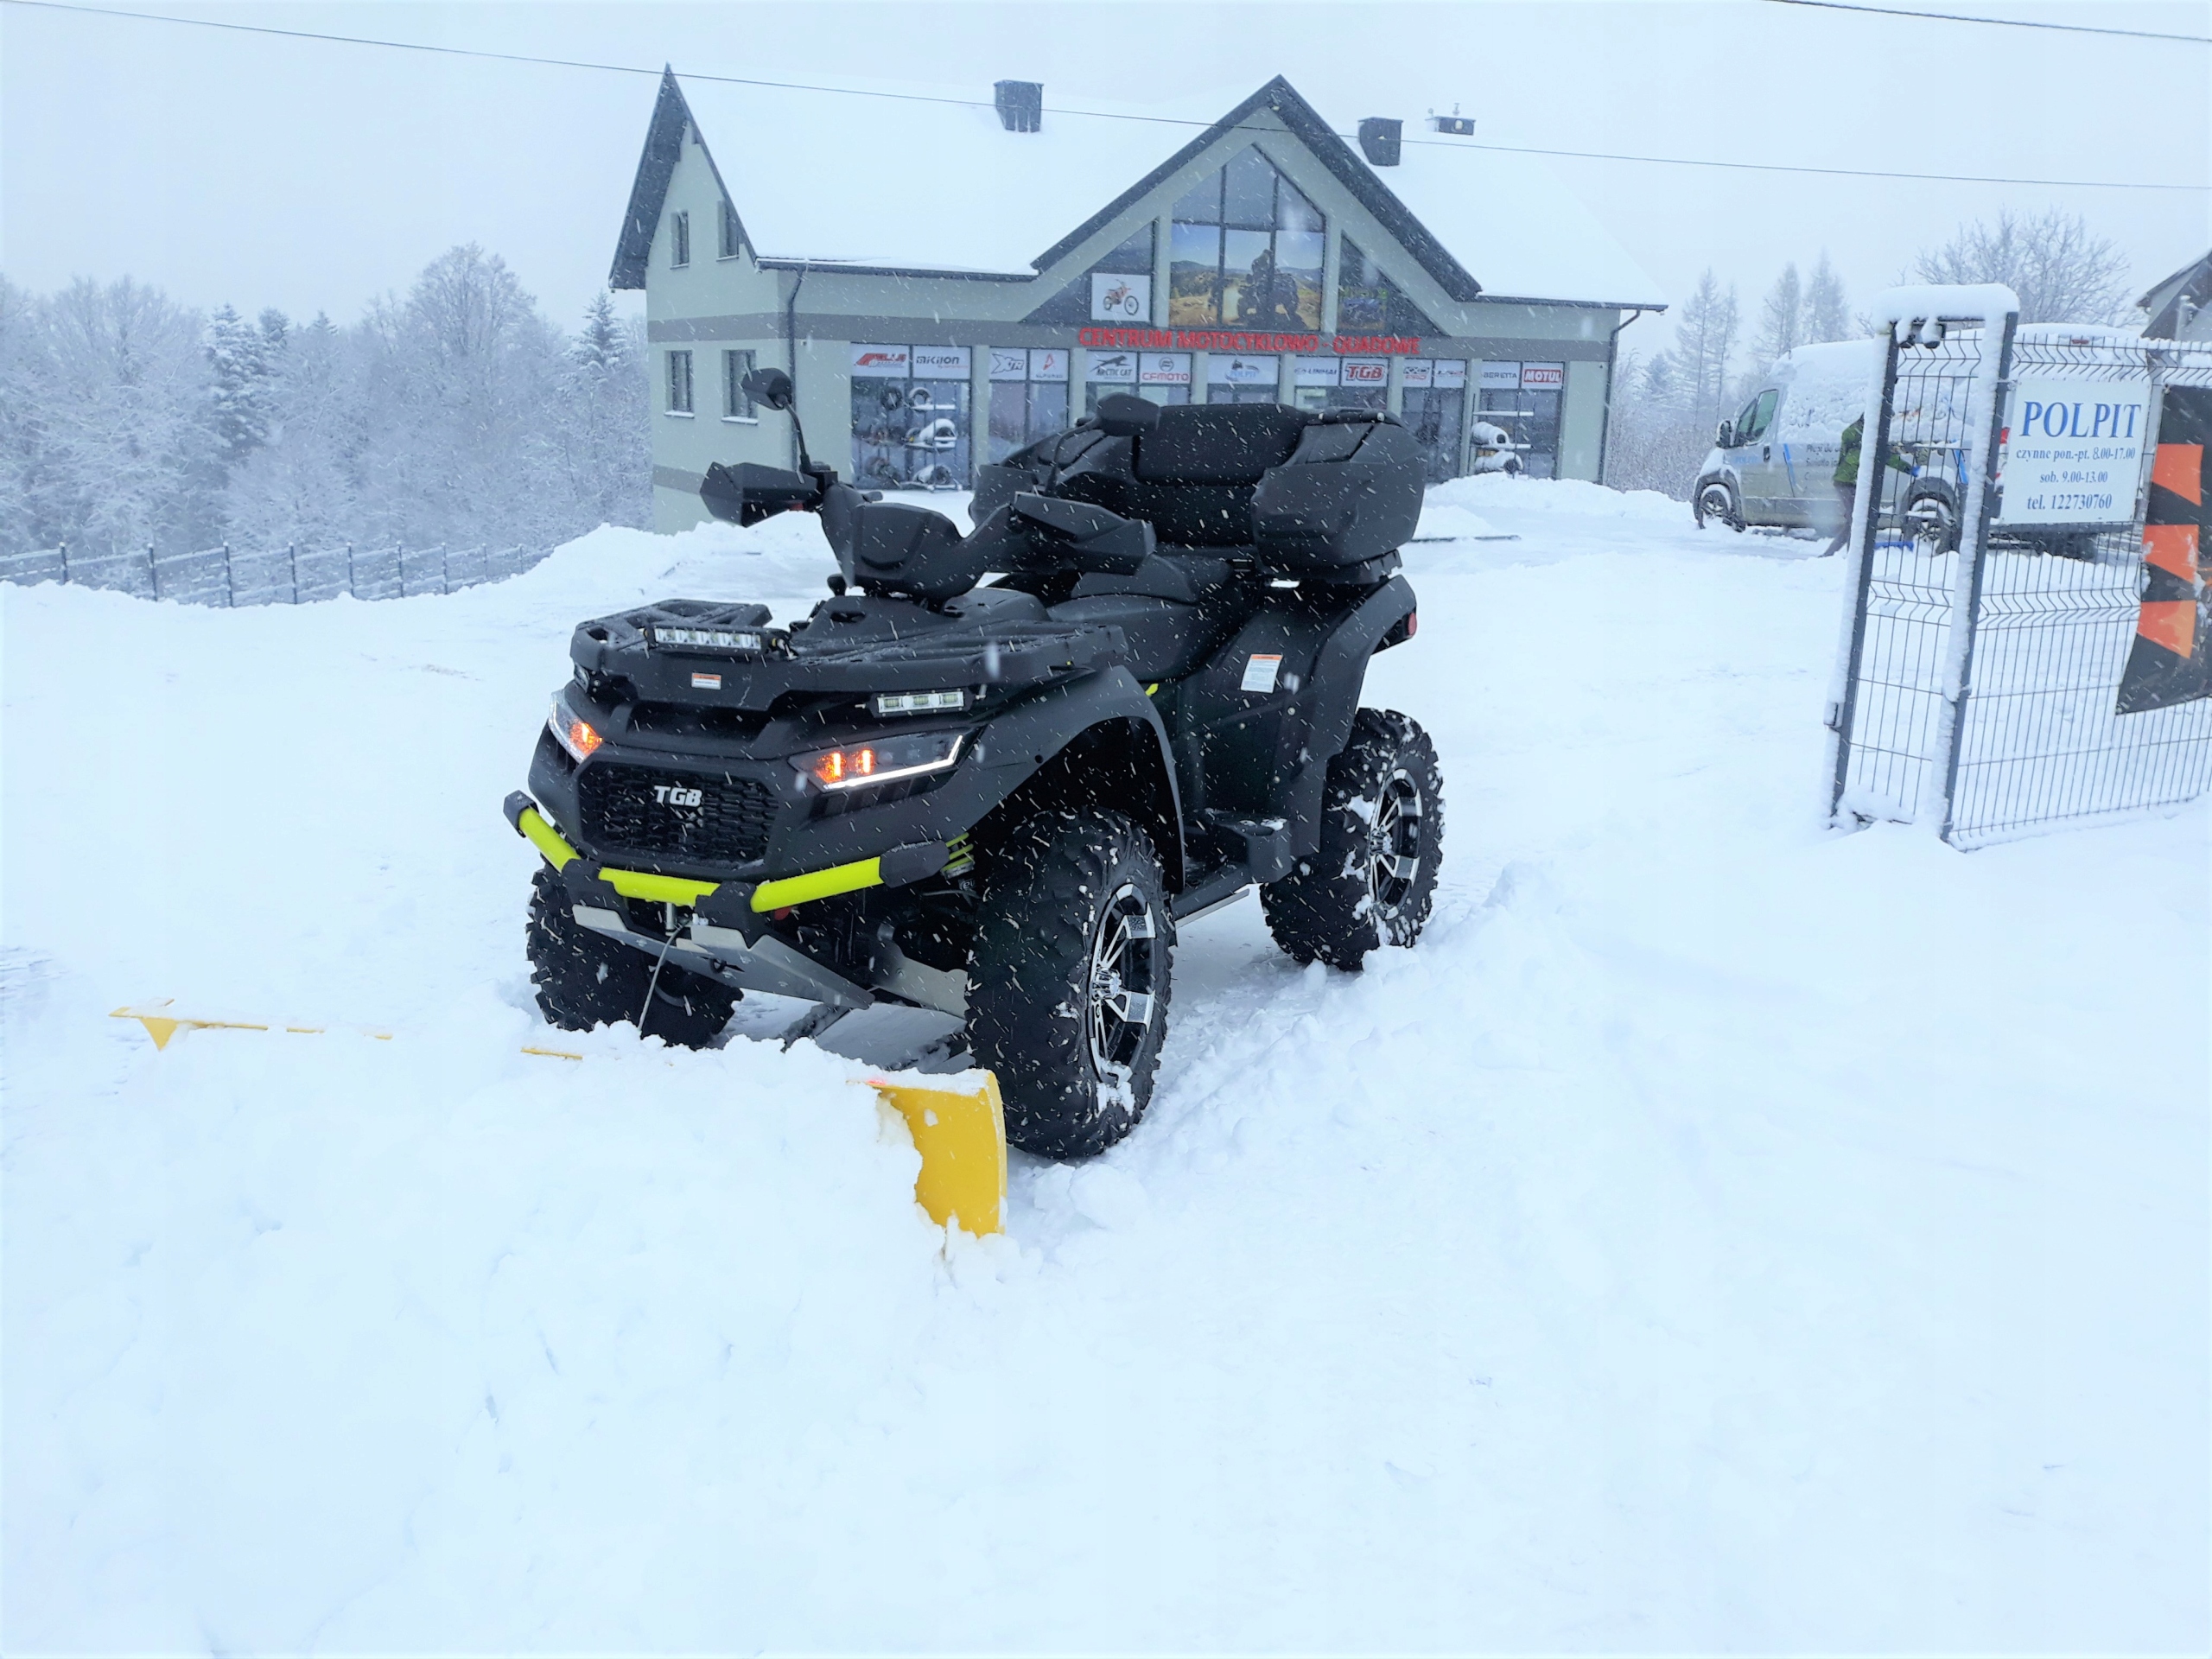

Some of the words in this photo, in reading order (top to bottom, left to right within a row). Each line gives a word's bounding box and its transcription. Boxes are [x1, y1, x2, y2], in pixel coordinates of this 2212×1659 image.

[1079, 327, 1172, 346] CENTRUM
[1177, 331, 1319, 352] MOTOCYKLOWO
[1332, 335, 1421, 355] QUADOWE
[1141, 372, 1190, 381] CFMOTO
[1346, 365, 1384, 380] TGB
[1523, 369, 1561, 383] MOTUL
[2018, 400, 2142, 439] POLPIT
[2016, 449, 2051, 462] czynne
[2053, 448, 2090, 462] pon.-pt.
[2092, 447, 2136, 460] 8.00-17.00
[2039, 471, 2059, 483] sob.
[2062, 470, 2108, 483] 9.00-13.00
[2027, 494, 2046, 510] tel.
[2050, 493, 2112, 510] 122730760
[654, 785, 702, 808] TGB
